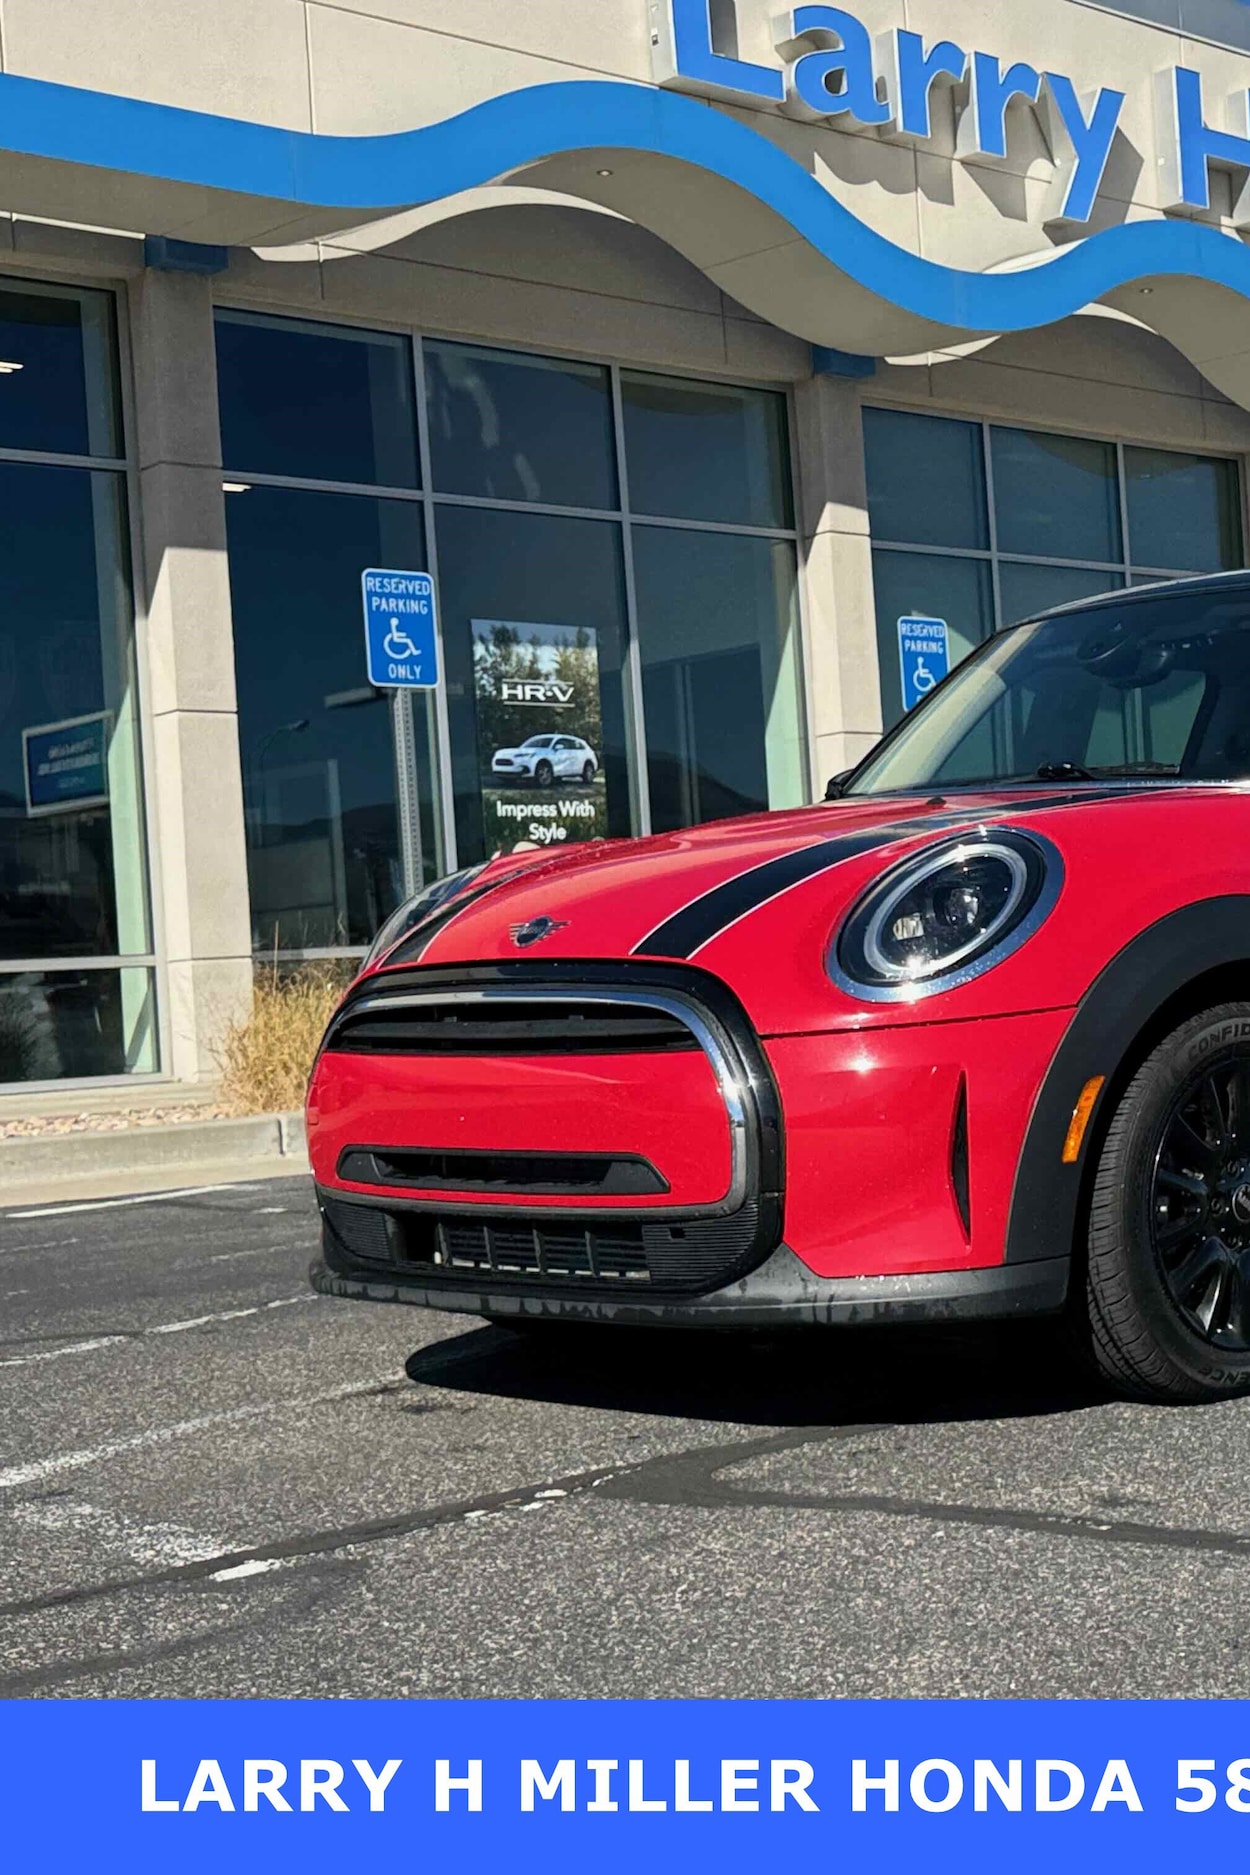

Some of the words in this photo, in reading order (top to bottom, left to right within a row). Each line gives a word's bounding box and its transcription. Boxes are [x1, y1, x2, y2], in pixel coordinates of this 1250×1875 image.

[668, 0, 1126, 223] Larry
[366, 576, 431, 596] RESERVED
[371, 596, 429, 615] PARKING
[900, 622, 946, 638] RESERVED
[904, 639, 944, 655] PARKING
[388, 663, 422, 680] ONLY
[496, 800, 557, 821] Impress
[558, 800, 596, 818] With
[528, 822, 567, 845] Style
